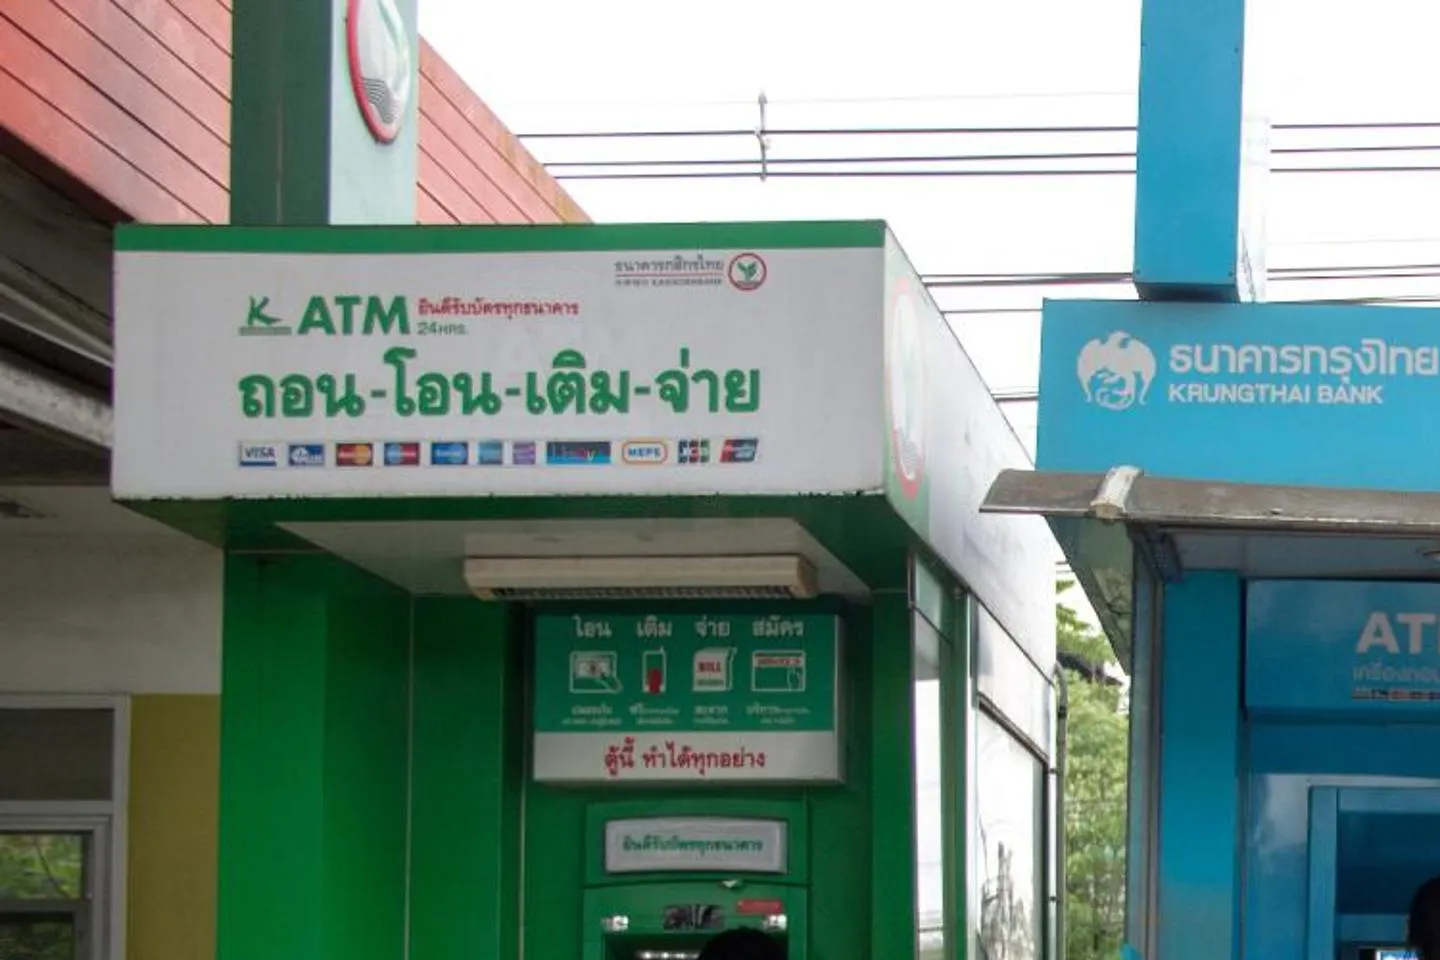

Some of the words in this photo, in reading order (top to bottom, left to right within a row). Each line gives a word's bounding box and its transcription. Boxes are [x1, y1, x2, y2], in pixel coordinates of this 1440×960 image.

[297, 295, 410, 335] ATM
[418, 297, 580, 320] ยินดีรับบัตรทุกธนาคาร
[1168, 337, 1440, 383] ธนาคารกรุงไทย
[238, 346, 760, 418] ถอน-โอน-เติม-จ่าย
[1168, 383, 1311, 403] KRUNGTHAI
[1317, 384, 1384, 405] BANK
[694, 615, 731, 638] จ่าย
[751, 616, 805, 638] สมัคร
[604, 737, 636, 777] ตู้นี้
[642, 742, 766, 777] ทำได้ทุกอย่าง
